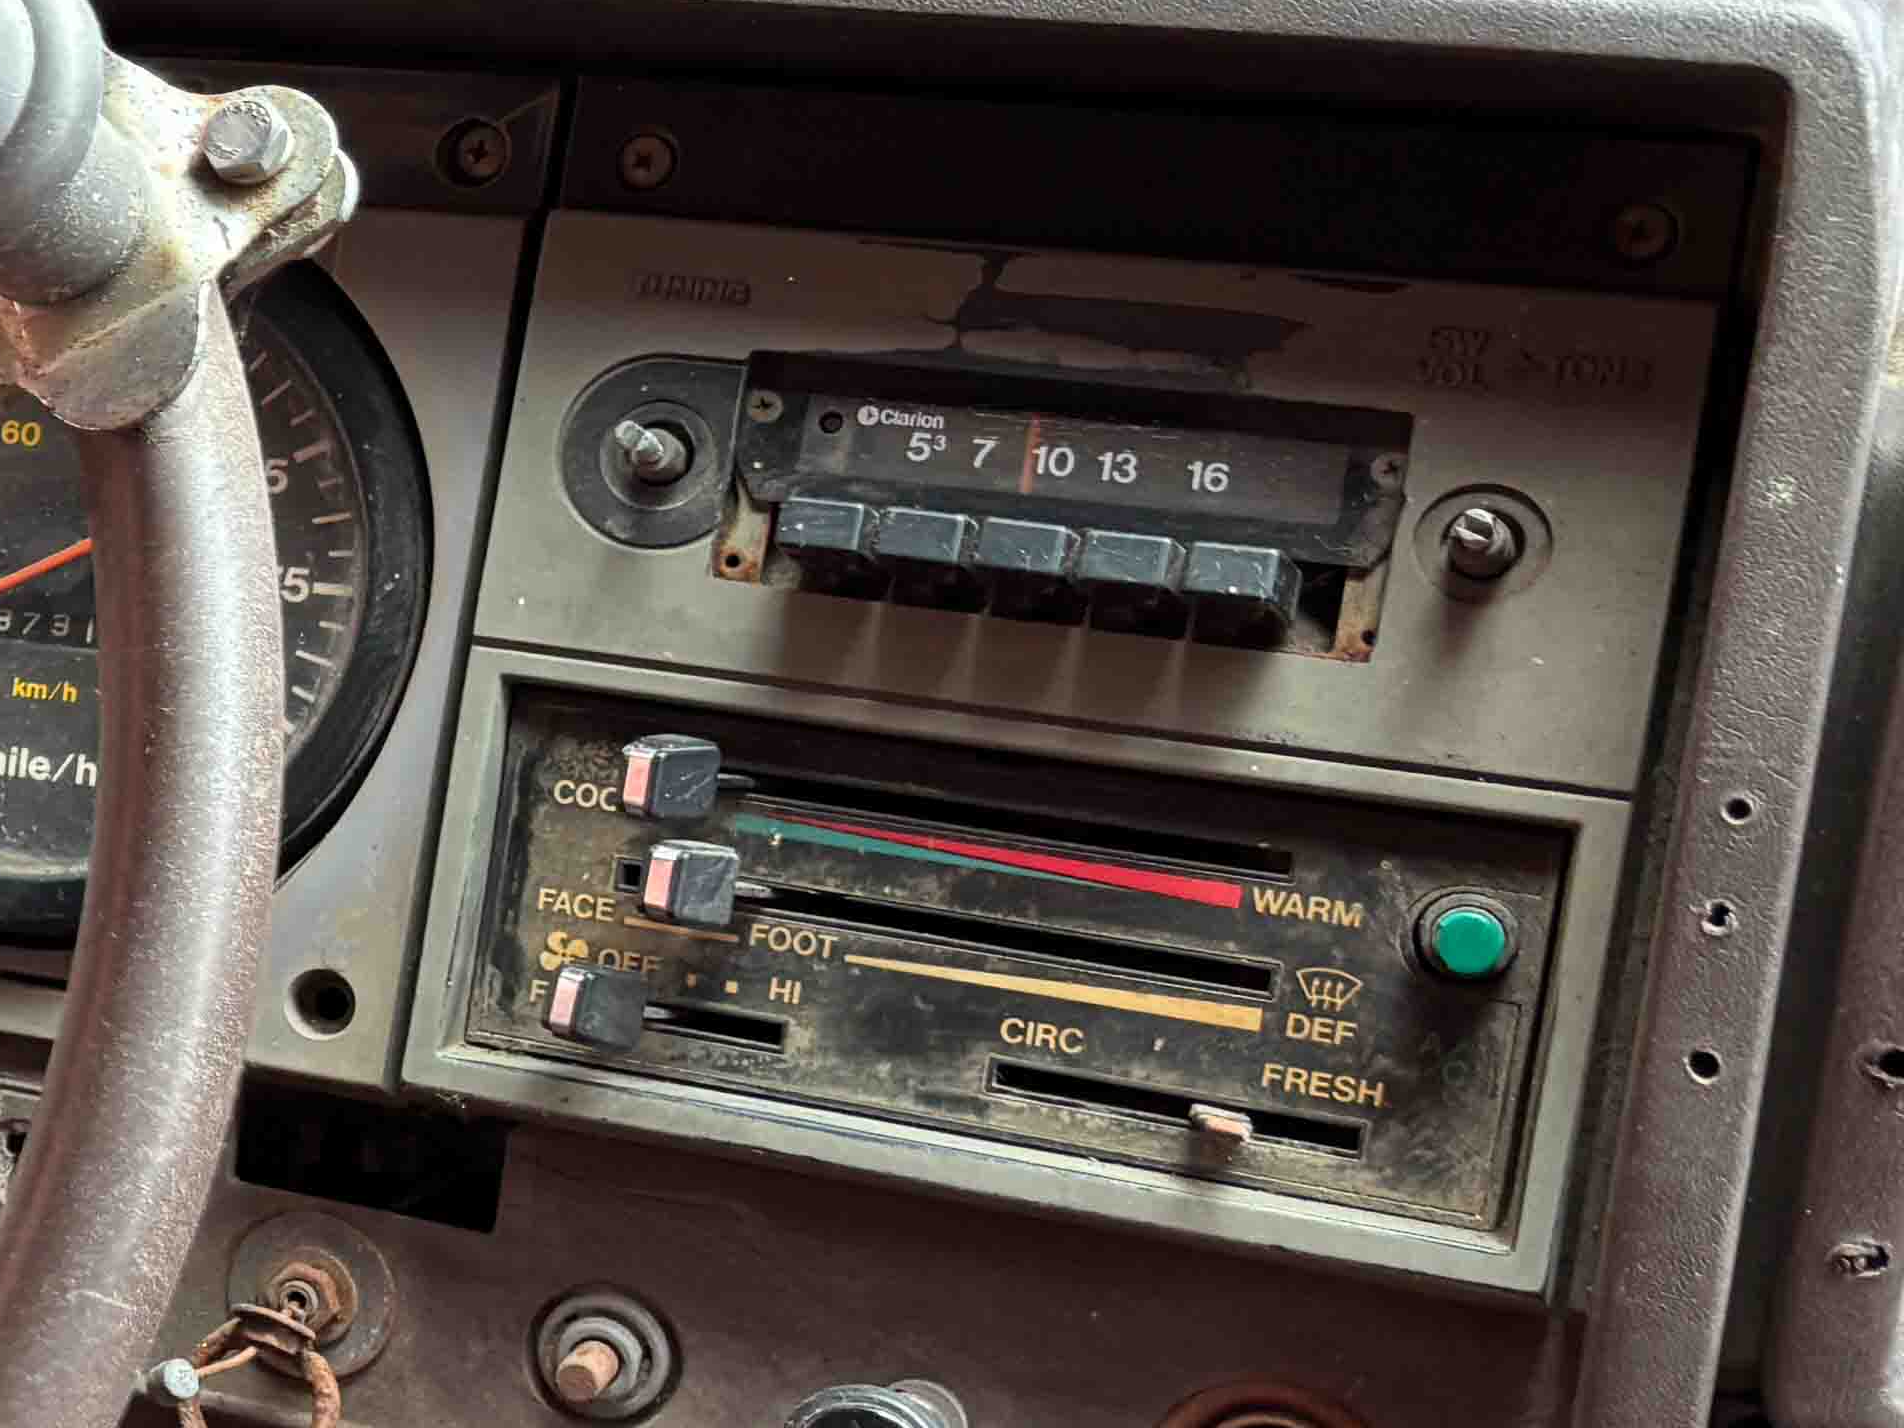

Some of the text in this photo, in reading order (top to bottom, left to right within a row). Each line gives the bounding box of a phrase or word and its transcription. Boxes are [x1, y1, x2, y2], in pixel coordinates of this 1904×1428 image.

[0, 420, 42, 447] 60
[880, 407, 945, 430] Clarion
[972, 438, 998, 470] 7
[1032, 446, 1075, 477] 10
[1097, 451, 1138, 484] 13
[1187, 461, 1230, 492] 16
[11, 677, 80, 704] km/h
[538, 888, 616, 922] FACE
[1252, 886, 1364, 929] WARM
[749, 923, 840, 960] FOOT
[768, 977, 802, 1005] HI
[999, 1018, 1087, 1055] CIRC
[1286, 1013, 1358, 1047] DEF
[1261, 1062, 1385, 1109] FRESH
